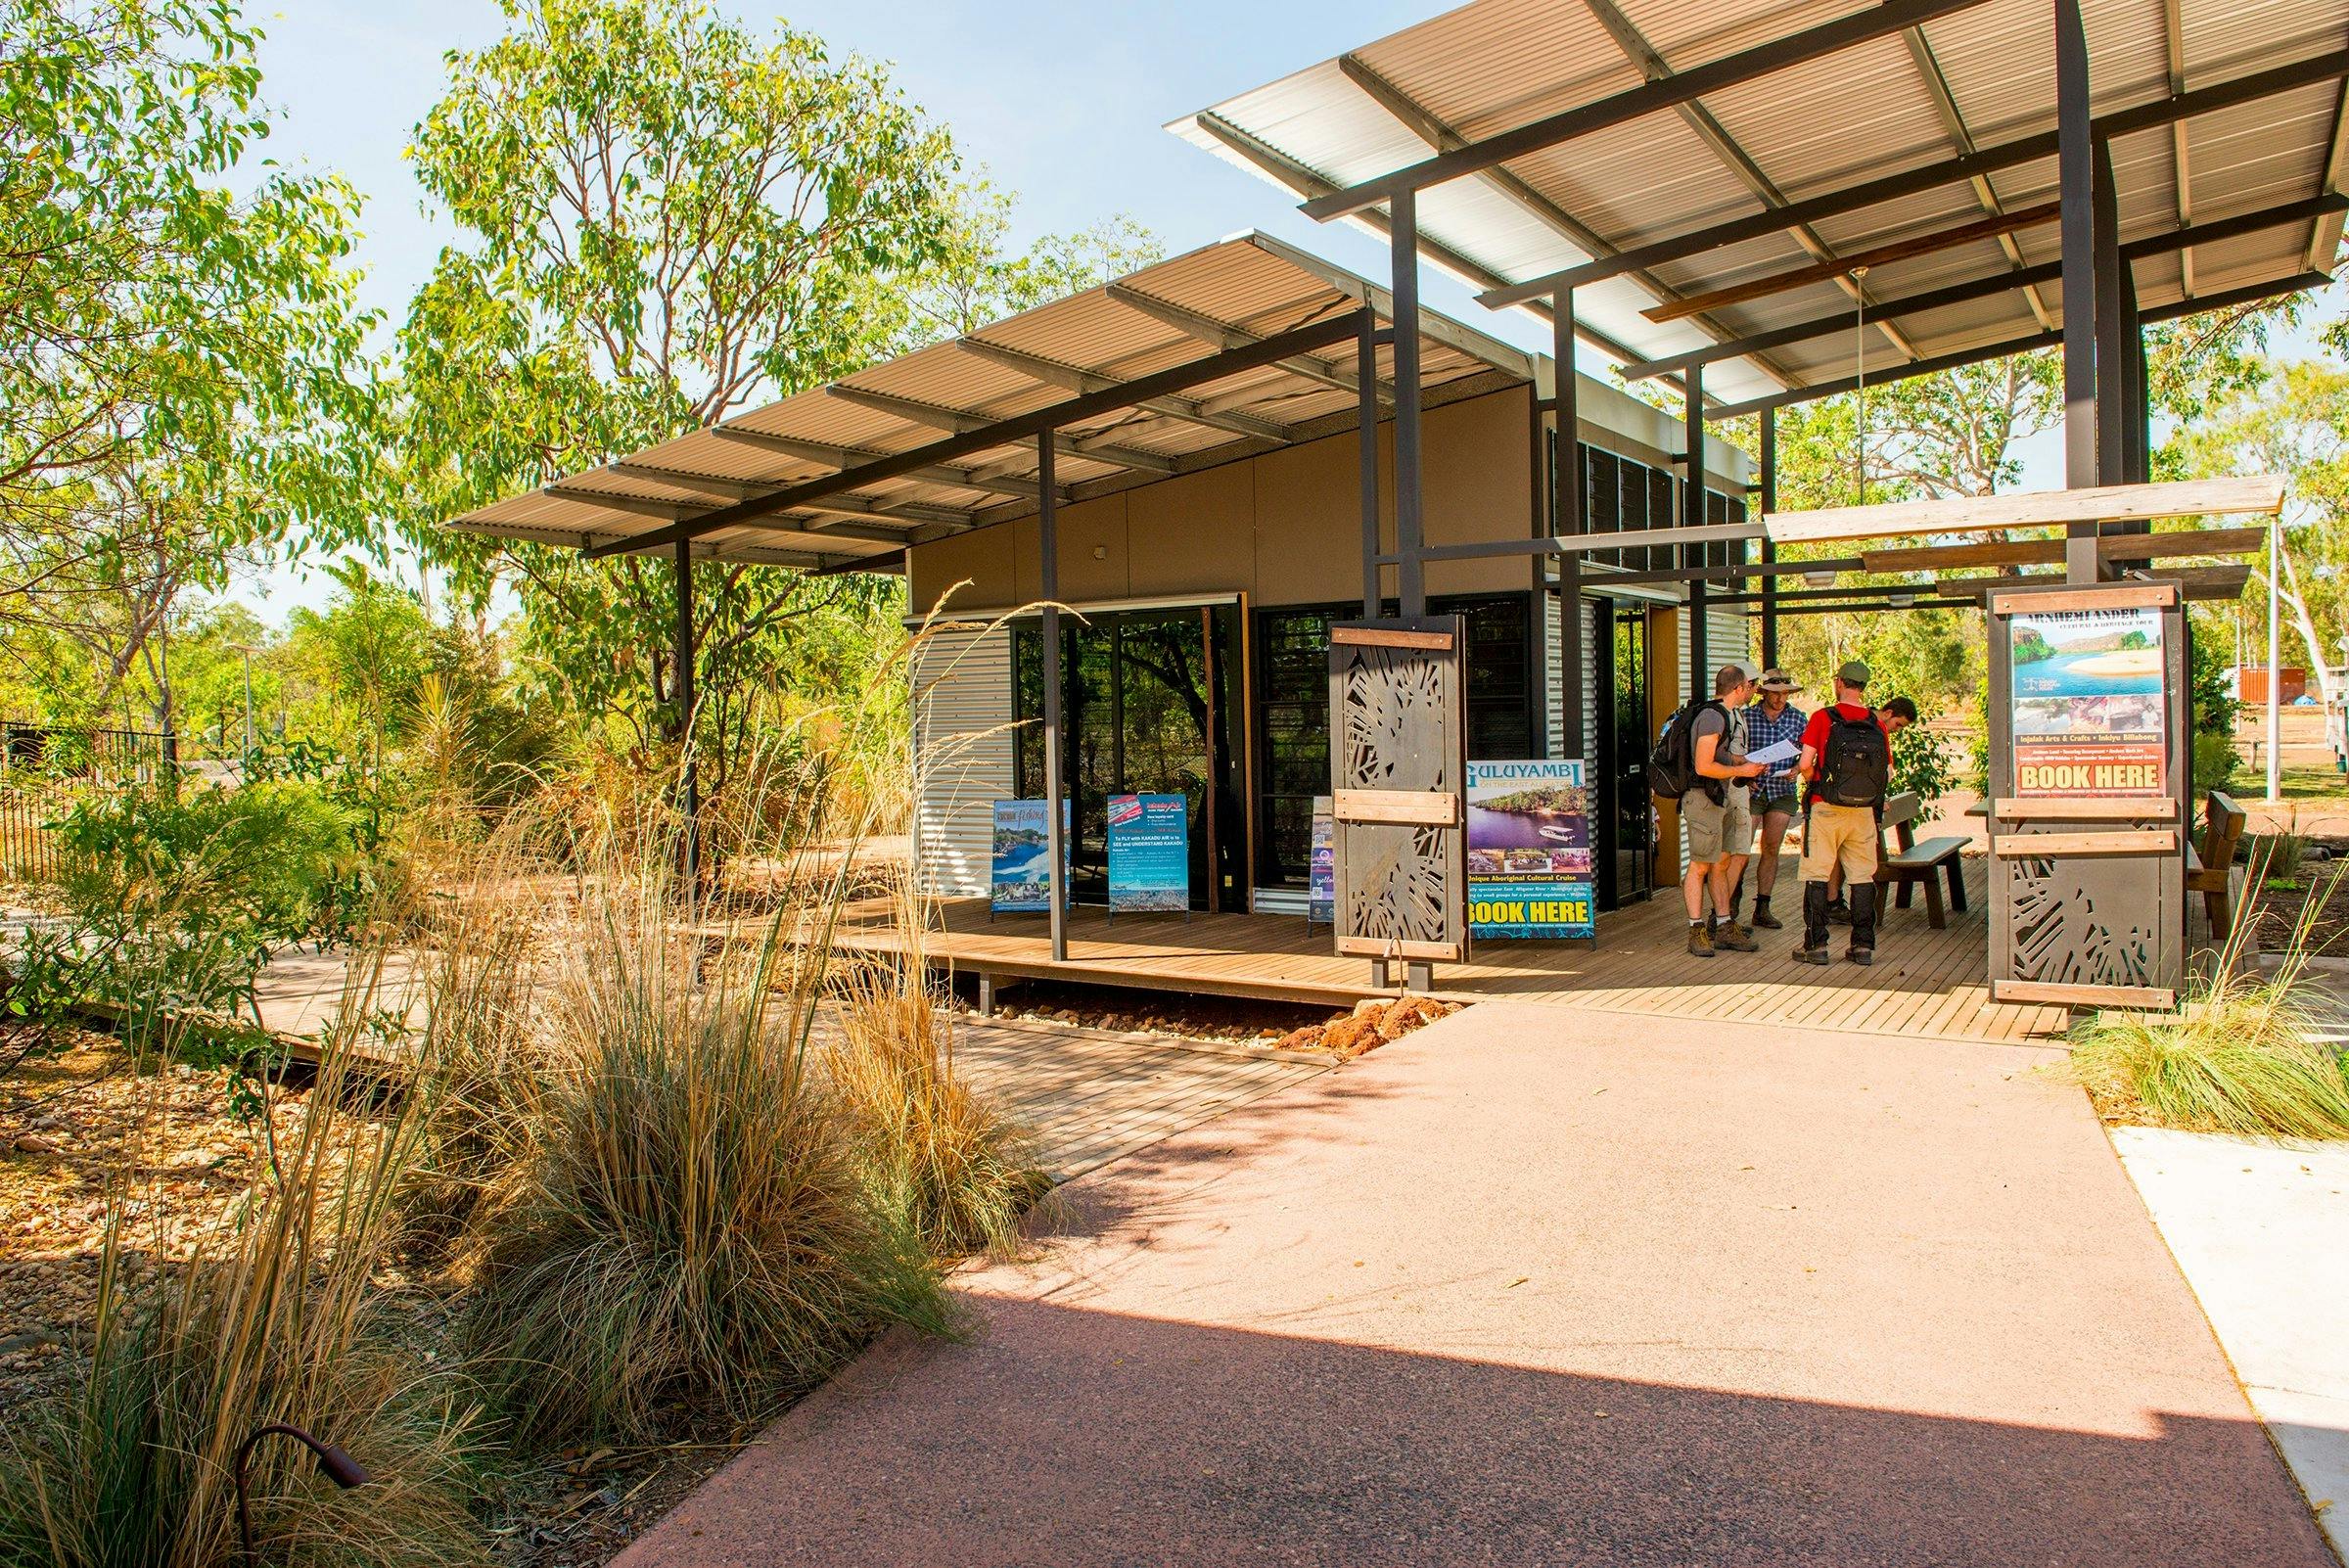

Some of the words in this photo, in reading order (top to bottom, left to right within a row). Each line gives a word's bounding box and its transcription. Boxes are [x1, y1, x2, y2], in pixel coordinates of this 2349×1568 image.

[2020, 735, 2043, 744] Injalak
[2098, 734, 2121, 743] Inkiyu
[2124, 733, 2157, 742] Billabong
[1467, 763, 1582, 788] GULUYAMBI
[2020, 764, 2092, 789] BOOK
[2094, 764, 2159, 788] HERE
[1491, 874, 1525, 883] Aboriginal
[1528, 901, 1589, 923] HERE
